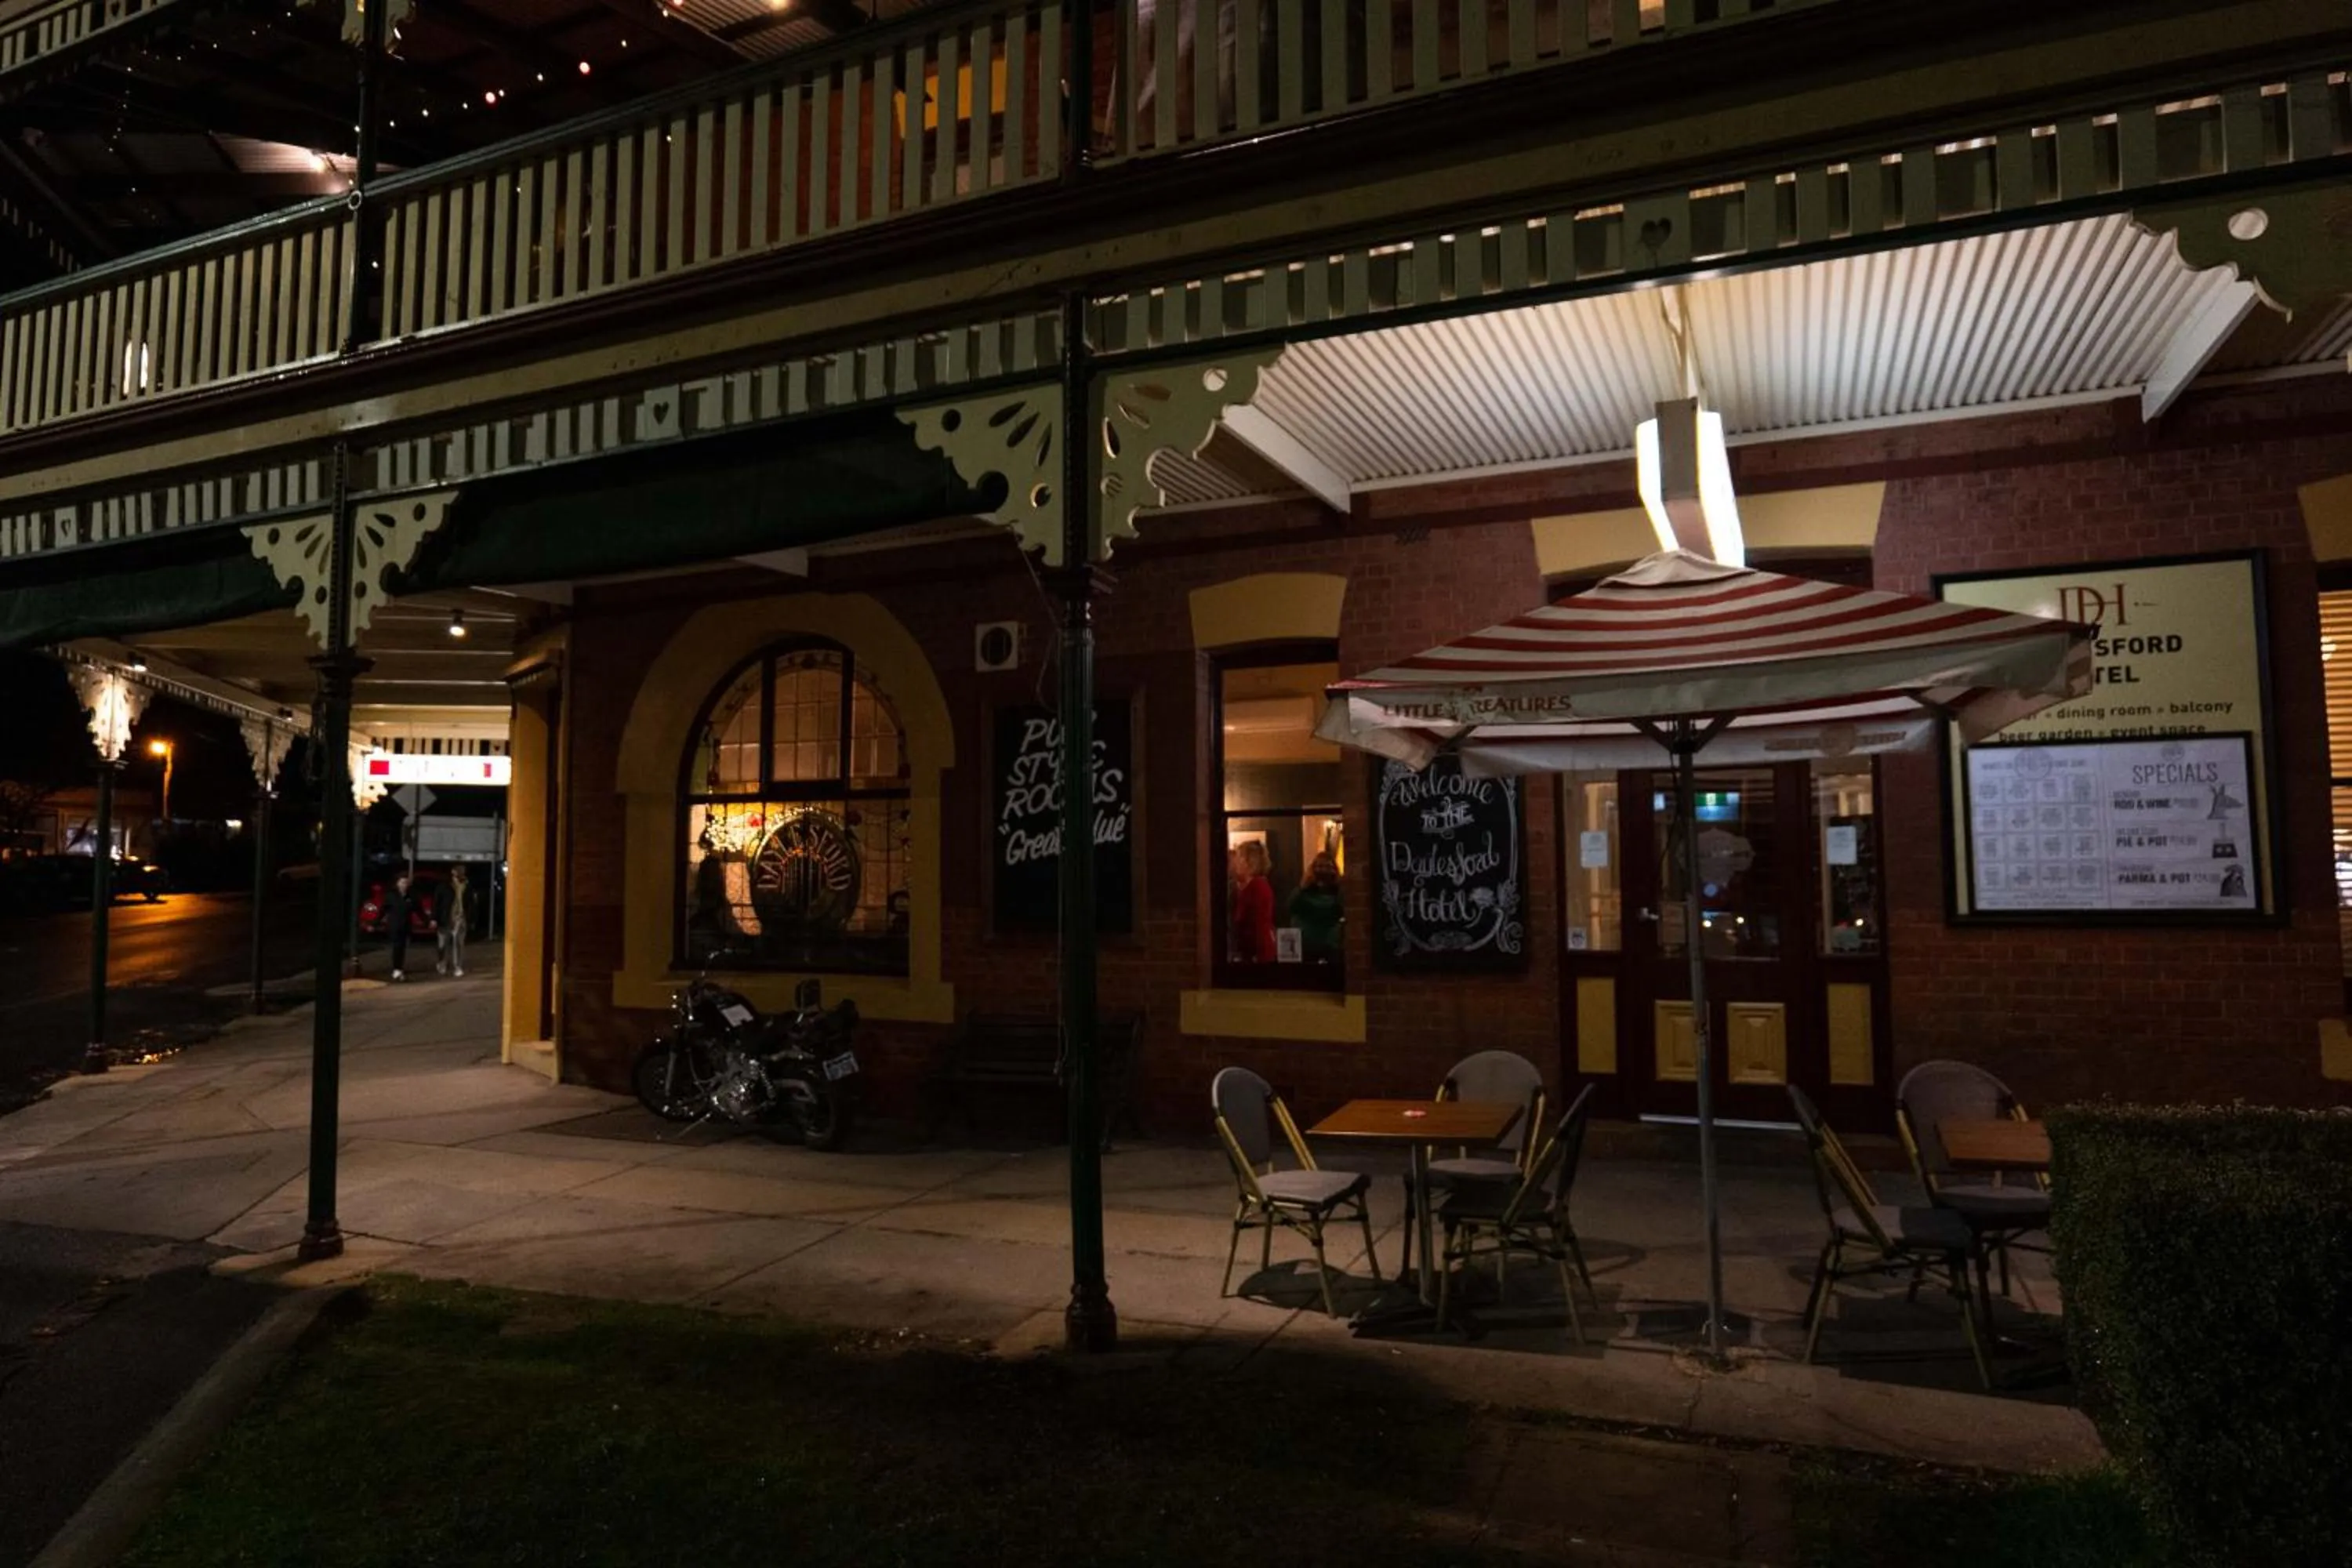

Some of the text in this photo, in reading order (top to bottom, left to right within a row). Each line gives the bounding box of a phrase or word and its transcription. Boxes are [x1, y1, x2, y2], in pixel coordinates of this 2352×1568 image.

[2094, 635, 2183, 657] SFORD
[2094, 666, 2140, 684] TEL
[1383, 702, 1445, 719] LITTLE
[2056, 701, 2234, 720] dining room balcony
[1999, 724, 2206, 742] beer garden event space
[2132, 761, 2218, 784] SPECIALS
[1002, 768, 1124, 820] ROOS
[1389, 831, 1501, 887] Daylesford
[2118, 873, 2156, 884] PARMA
[1400, 887, 1478, 928] Hotel
